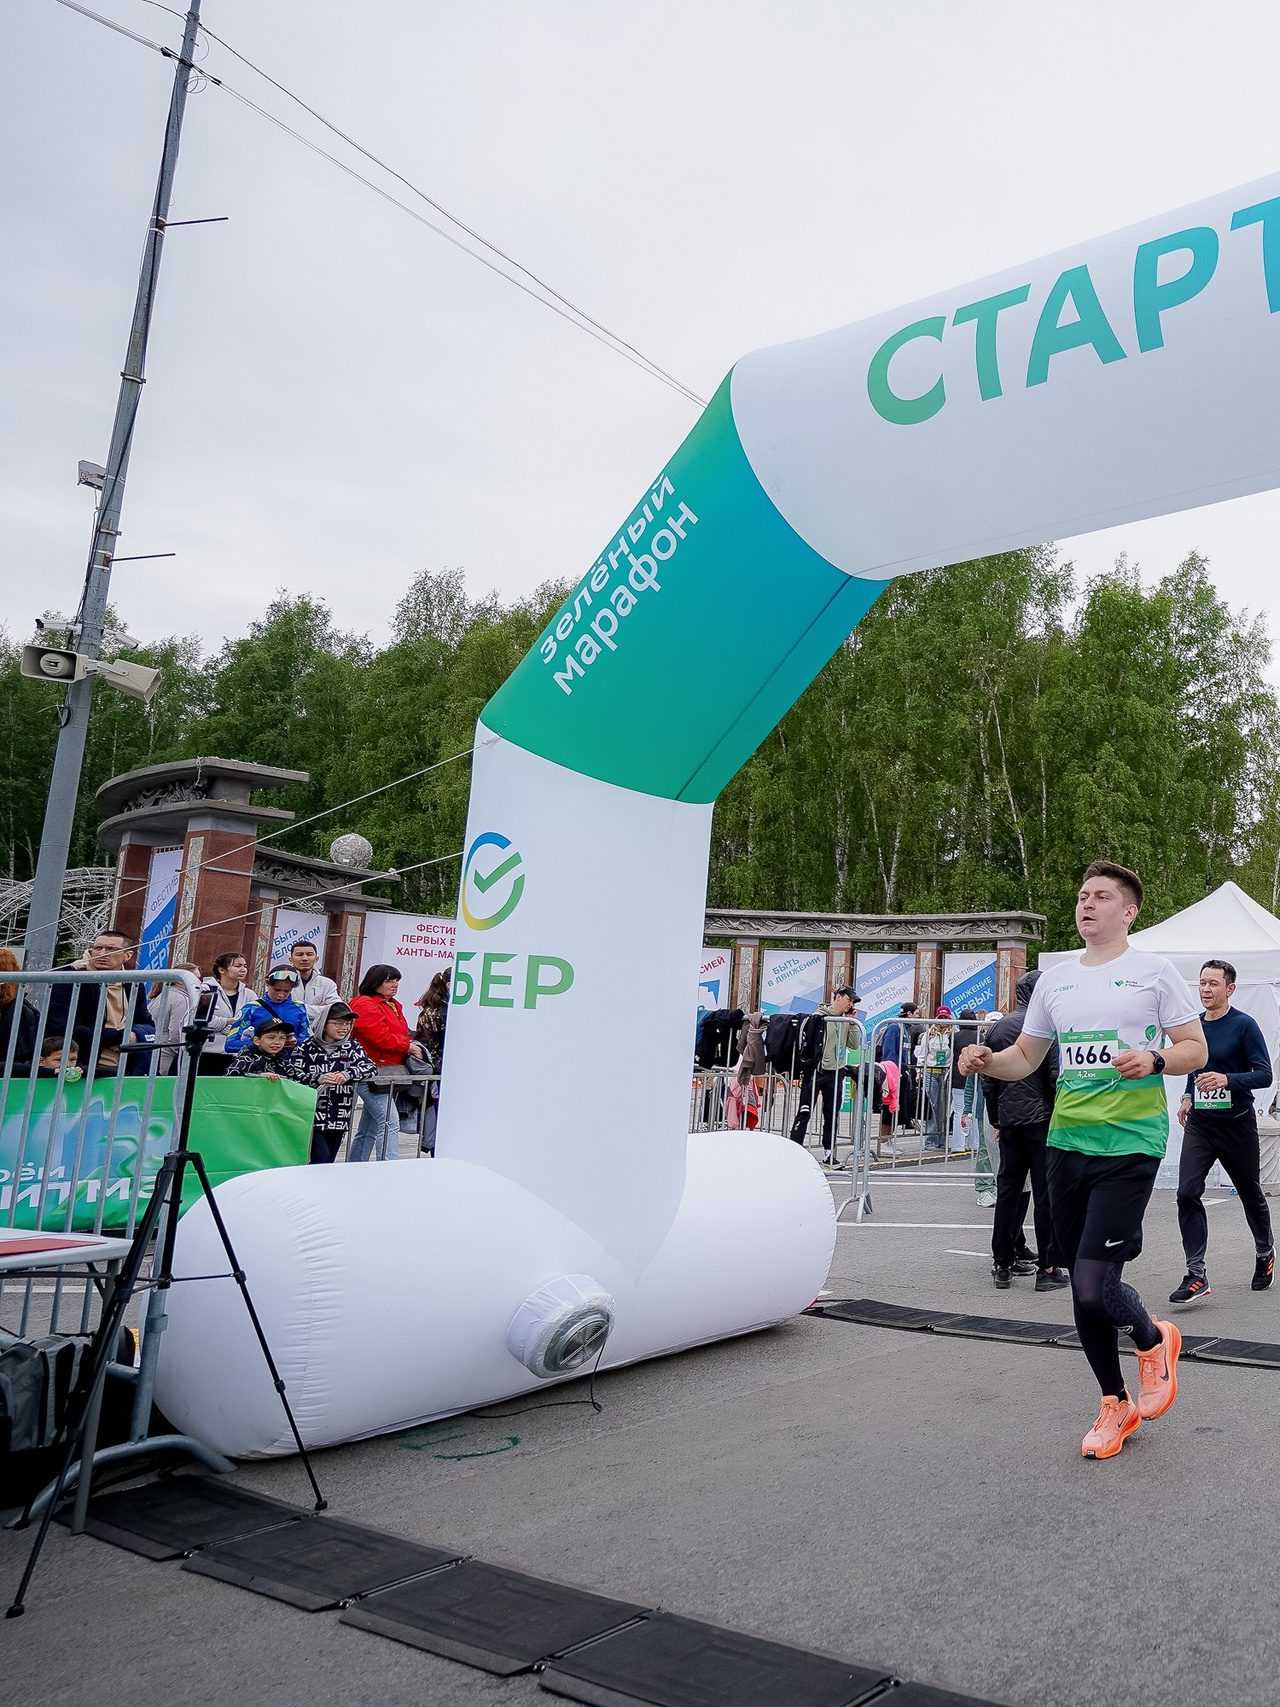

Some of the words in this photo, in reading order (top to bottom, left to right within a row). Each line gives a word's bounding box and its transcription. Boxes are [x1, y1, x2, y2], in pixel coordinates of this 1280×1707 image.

[541, 473, 677, 665] зелёный
[553, 502, 700, 696] марафон
[274, 929, 298, 946] БЫТЬ
[402, 934, 447, 946] ПЕРВЫХ
[767, 979, 774, 987] В
[776, 956, 821, 984] ДВИЖЕНИИ
[772, 957, 800, 975] БЫТЬ
[860, 976, 881, 990] БЫТЬ
[881, 958, 911, 979] ВМЕСТЕ
[948, 959, 986, 985] ФЕСТИВАЛЬ
[451, 951, 575, 1010] БЕР
[875, 985, 896, 1000] БЫТЬ
[950, 975, 993, 1008] ДВИЖЕНИЕ
[875, 985, 909, 1008] РОССИЕЙ
[951, 987, 994, 1020] ЕРВЫХ
[1066, 1045, 1111, 1065] 1666
[1198, 1088, 1226, 1099] 1326
